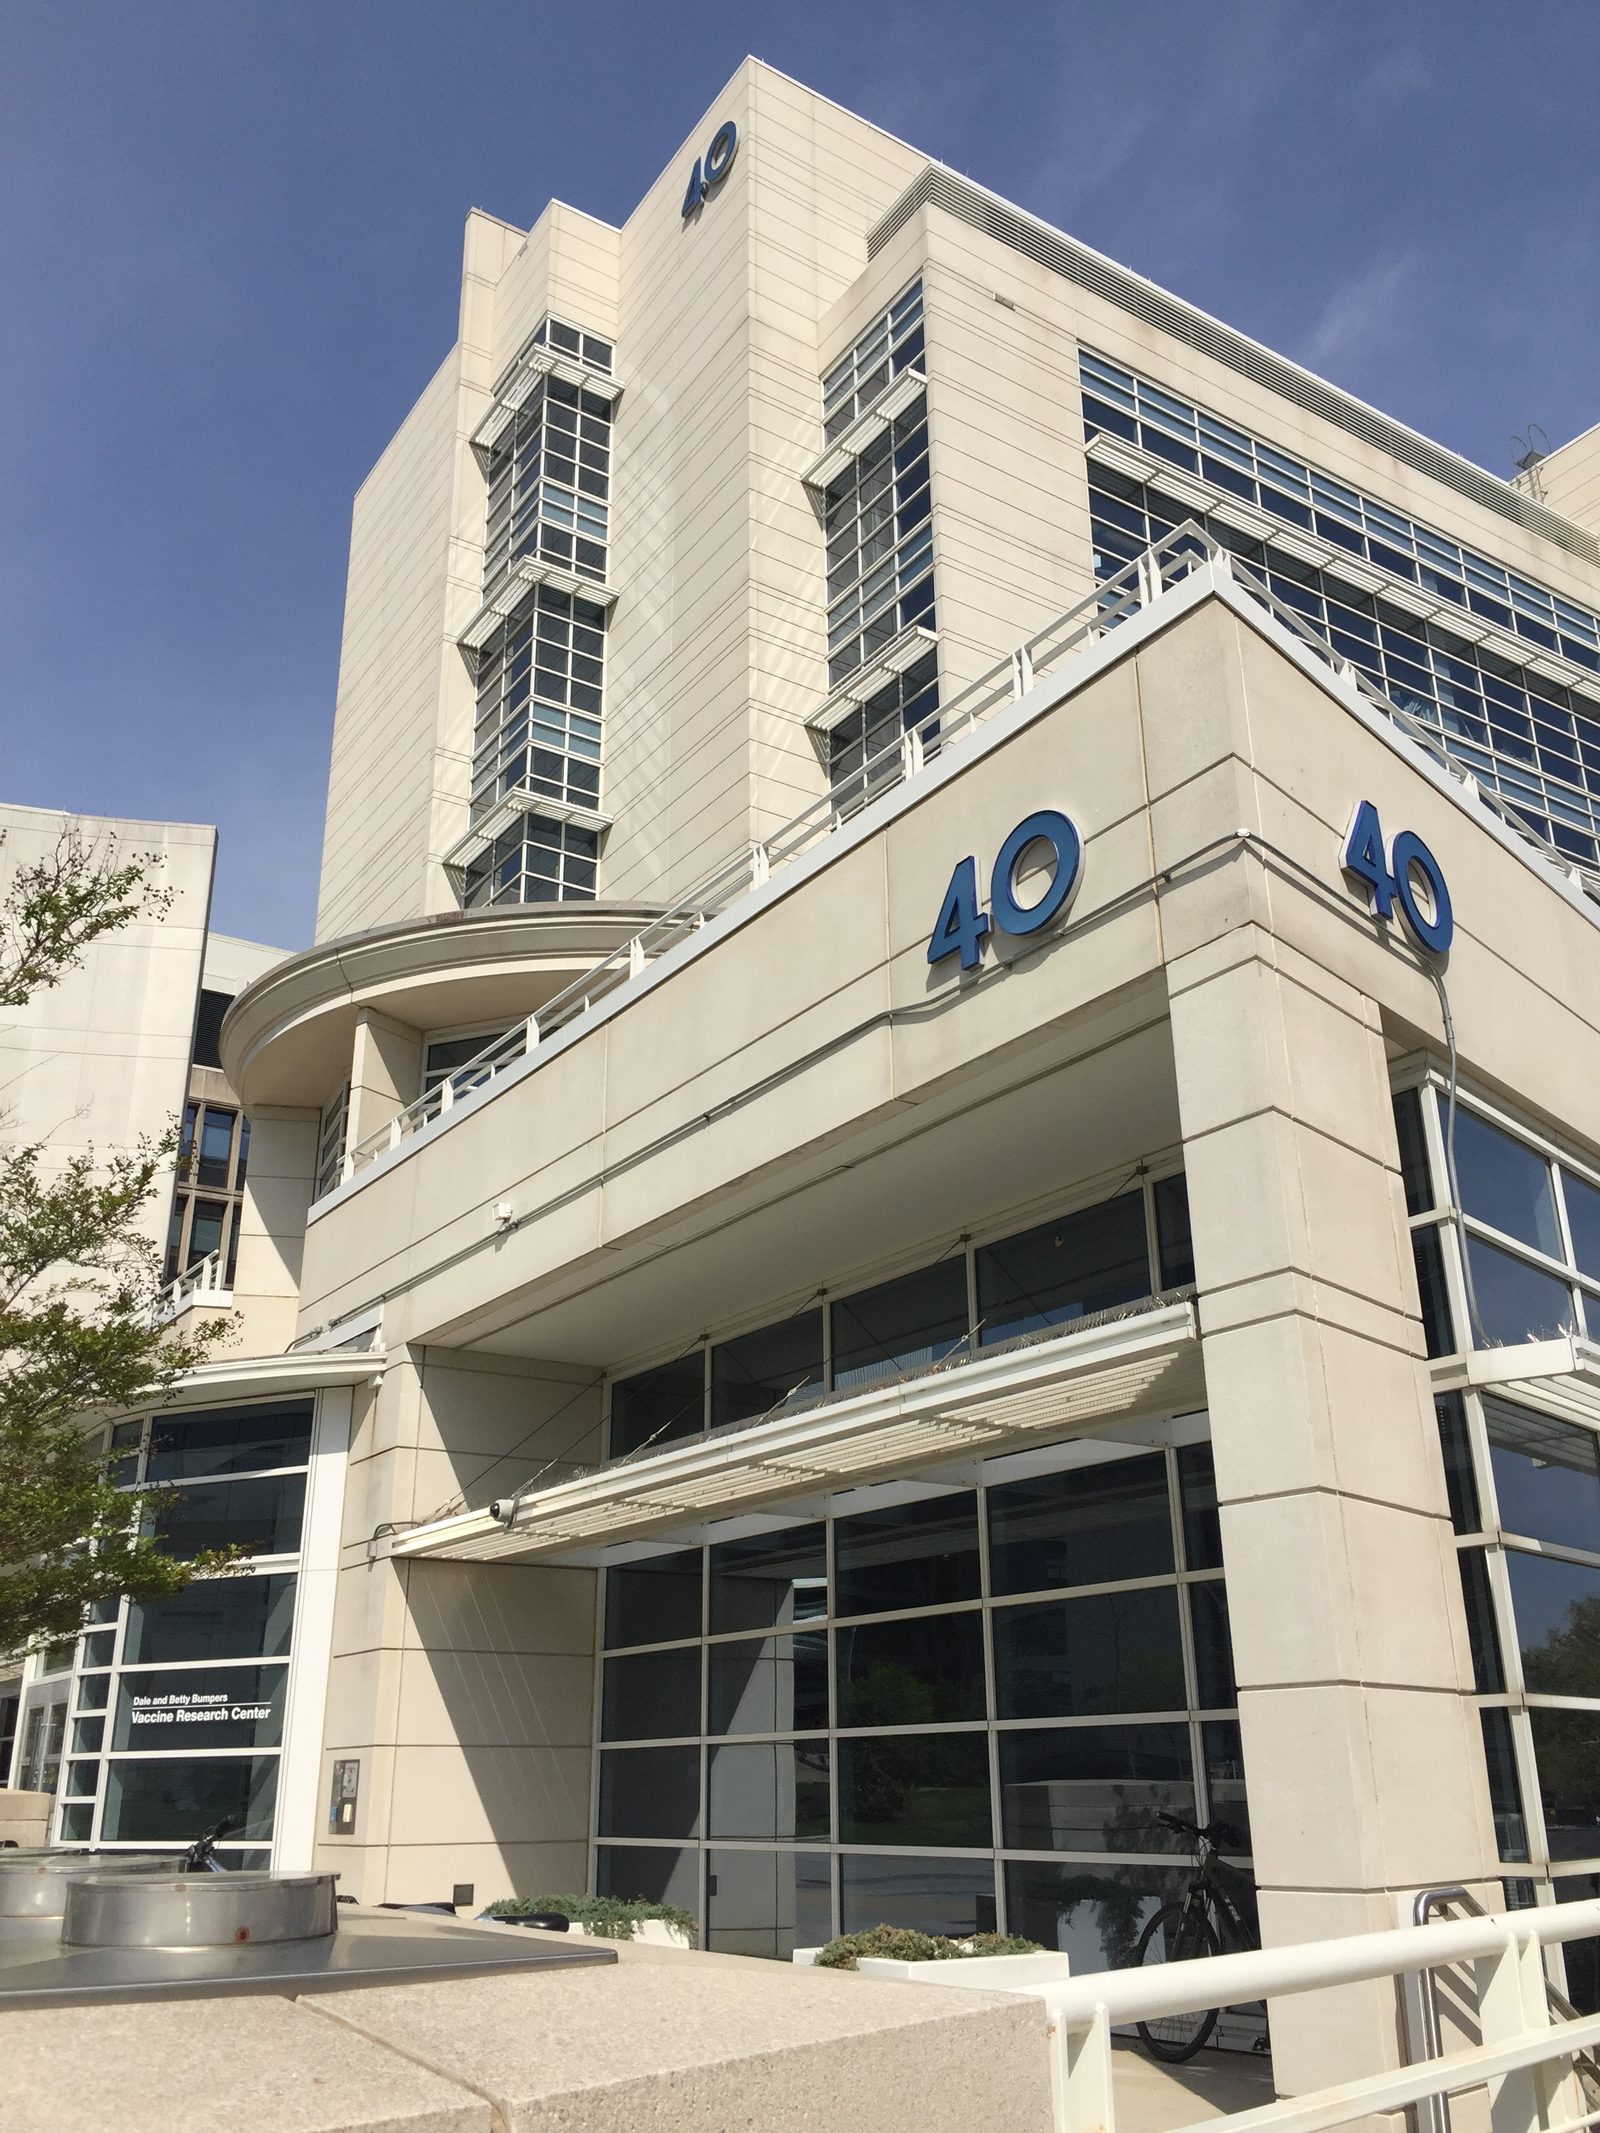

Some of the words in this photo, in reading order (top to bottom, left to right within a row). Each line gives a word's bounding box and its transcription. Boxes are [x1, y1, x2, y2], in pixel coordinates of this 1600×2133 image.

[681, 121, 738, 218] 40
[928, 809, 1085, 971] 40
[1340, 800, 1454, 953] 40
[131, 1710, 174, 1724] Vaccine
[176, 1708, 229, 1722] Research
[231, 1706, 271, 1720] Center
[133, 1696, 151, 1706] Dale
[152, 1695, 168, 1705] and
[169, 1694, 191, 1705] Betty
[192, 1693, 228, 1704] Bumpers
